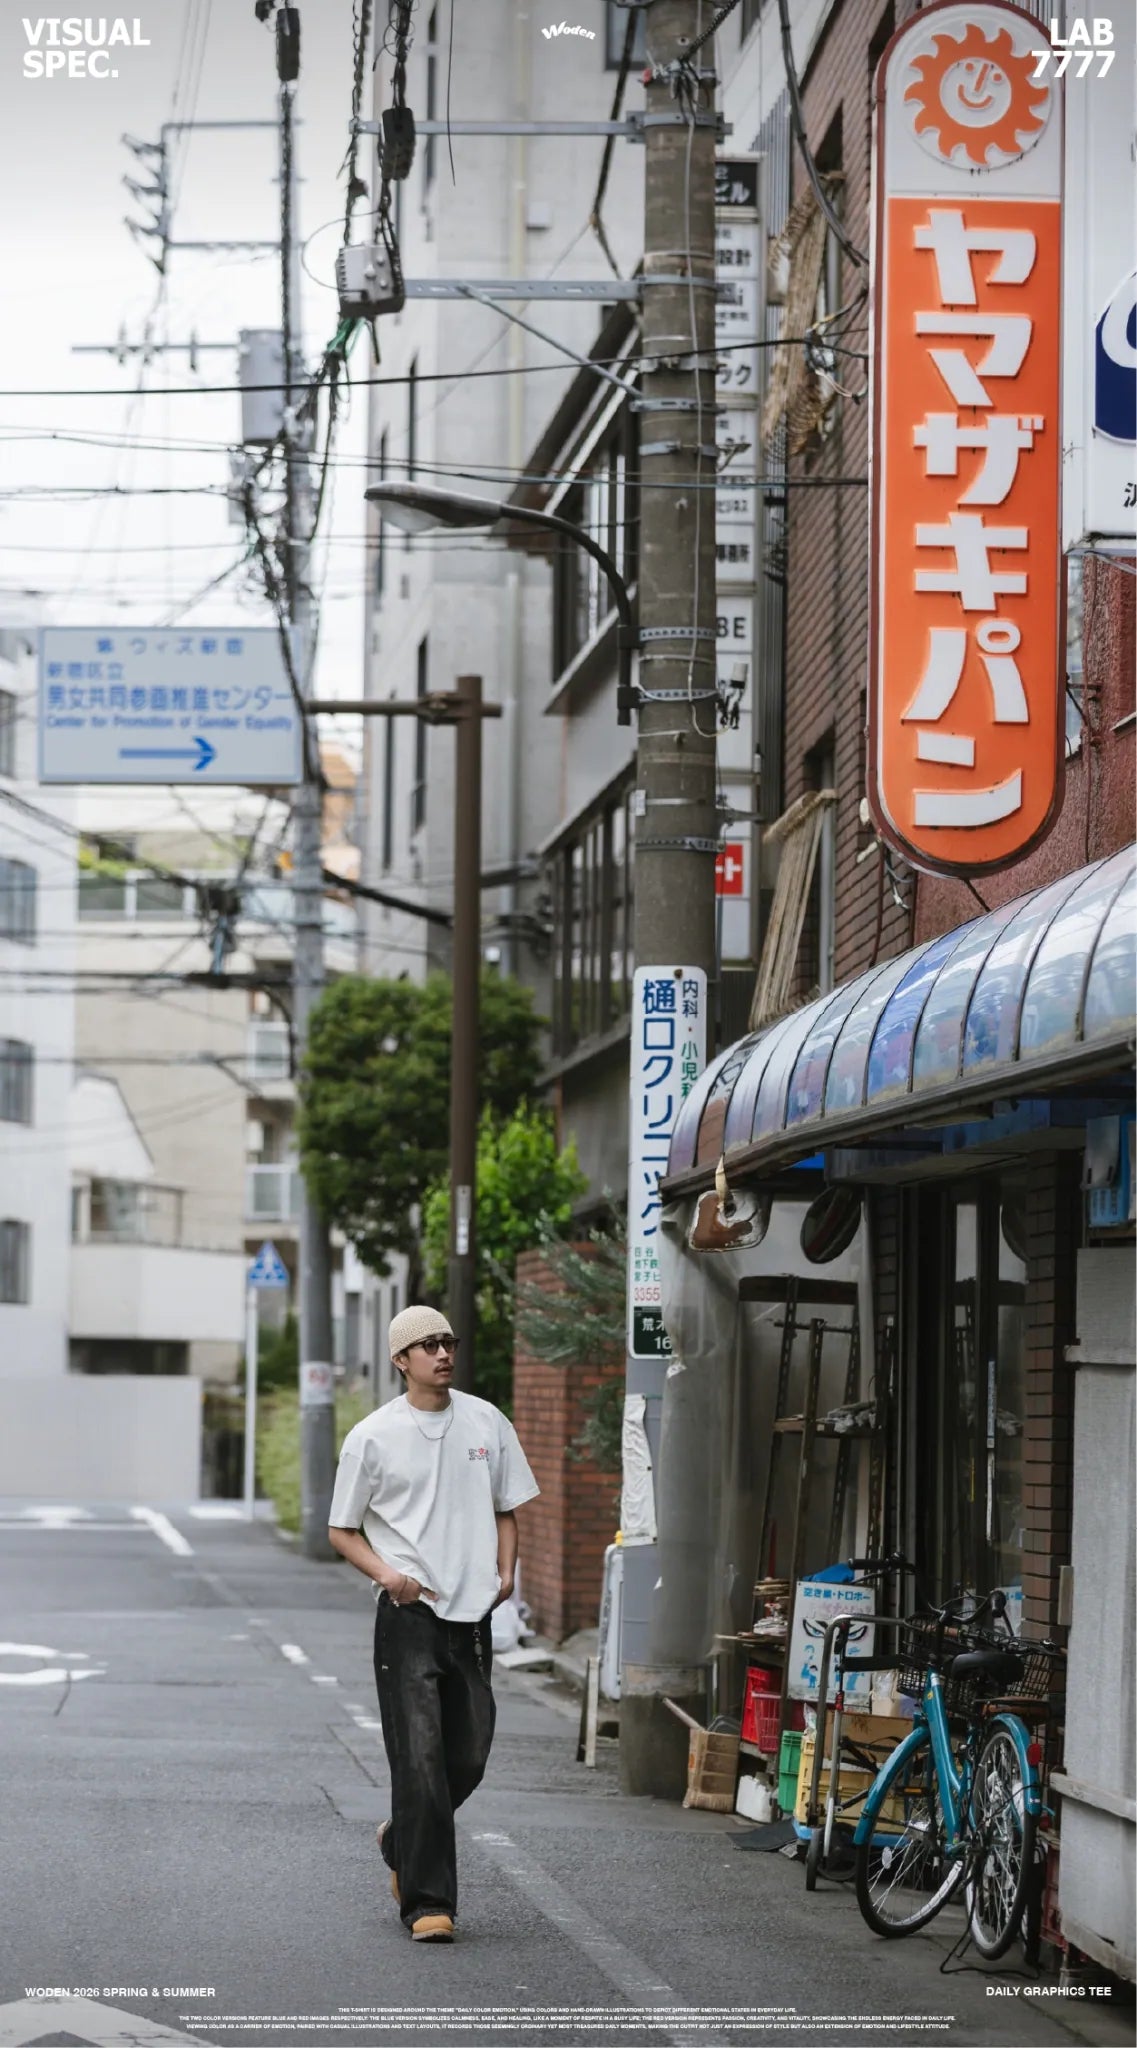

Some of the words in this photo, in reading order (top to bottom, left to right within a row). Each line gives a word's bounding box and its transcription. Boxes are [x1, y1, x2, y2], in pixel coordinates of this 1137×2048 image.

[900, 207, 1045, 828] ヤマザキパン
[47, 714, 86, 729] Center
[180, 714, 191, 729] of
[197, 714, 239, 729] Gender
[245, 714, 293, 731] Equality
